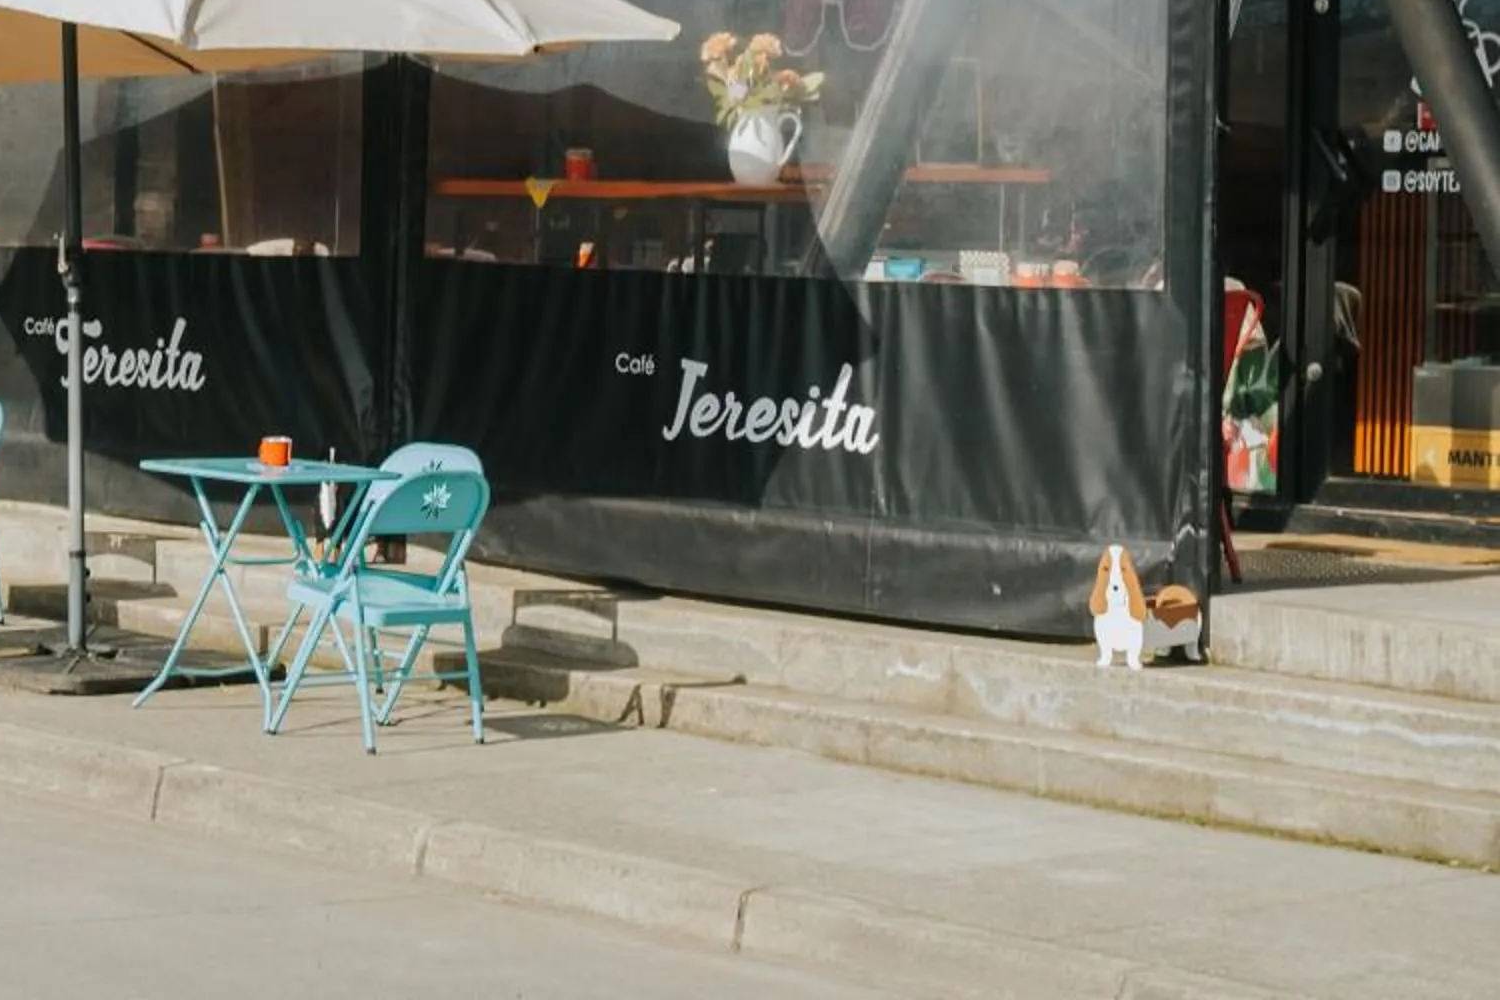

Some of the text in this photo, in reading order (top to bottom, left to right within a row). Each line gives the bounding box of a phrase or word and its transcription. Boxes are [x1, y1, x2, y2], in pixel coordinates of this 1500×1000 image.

[1405, 129, 1441, 153] @CA
[1404, 168, 1460, 193] @SOYTE
[24, 316, 55, 336] Café
[614, 352, 880, 454] Café Teresita
[1447, 449, 1500, 468] MANT
